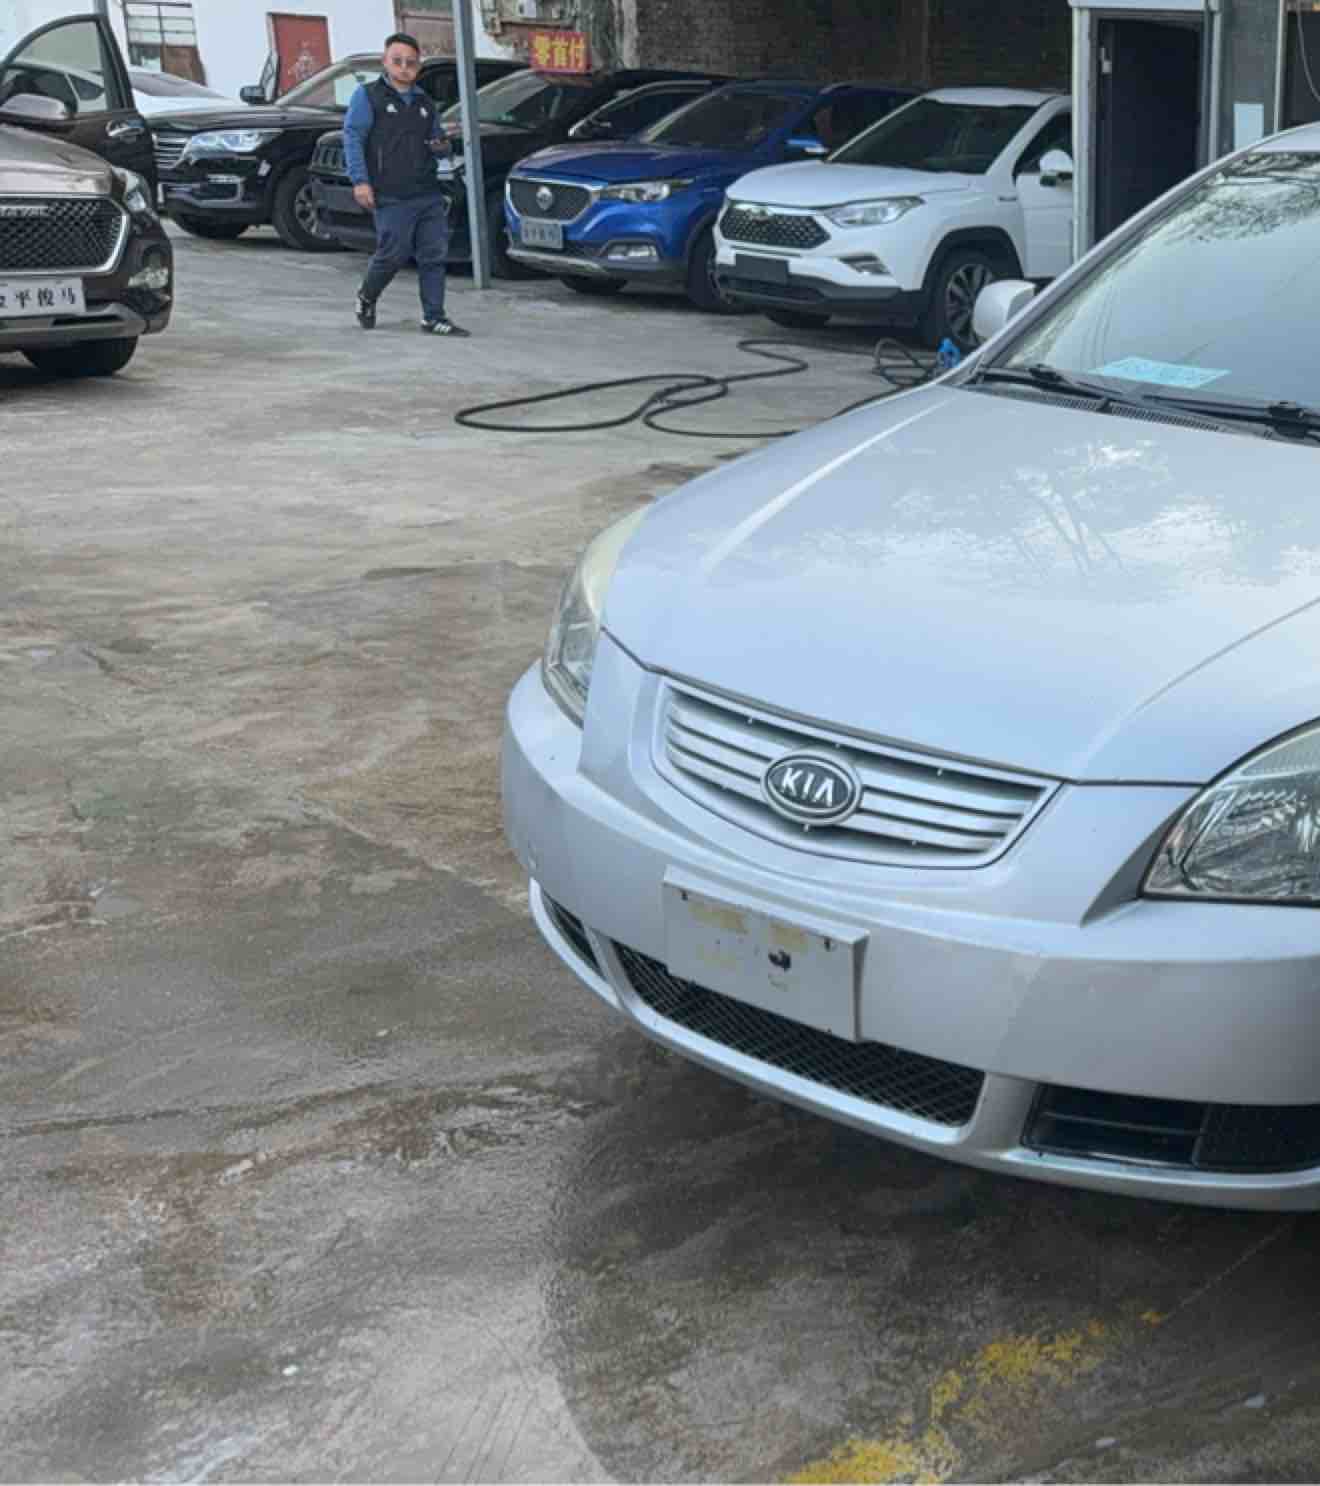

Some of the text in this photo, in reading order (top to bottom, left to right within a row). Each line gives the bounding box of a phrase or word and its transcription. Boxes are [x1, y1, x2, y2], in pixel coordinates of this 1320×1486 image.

[534, 35, 588, 69] 零首付
[781, 767, 834, 808] KIA
